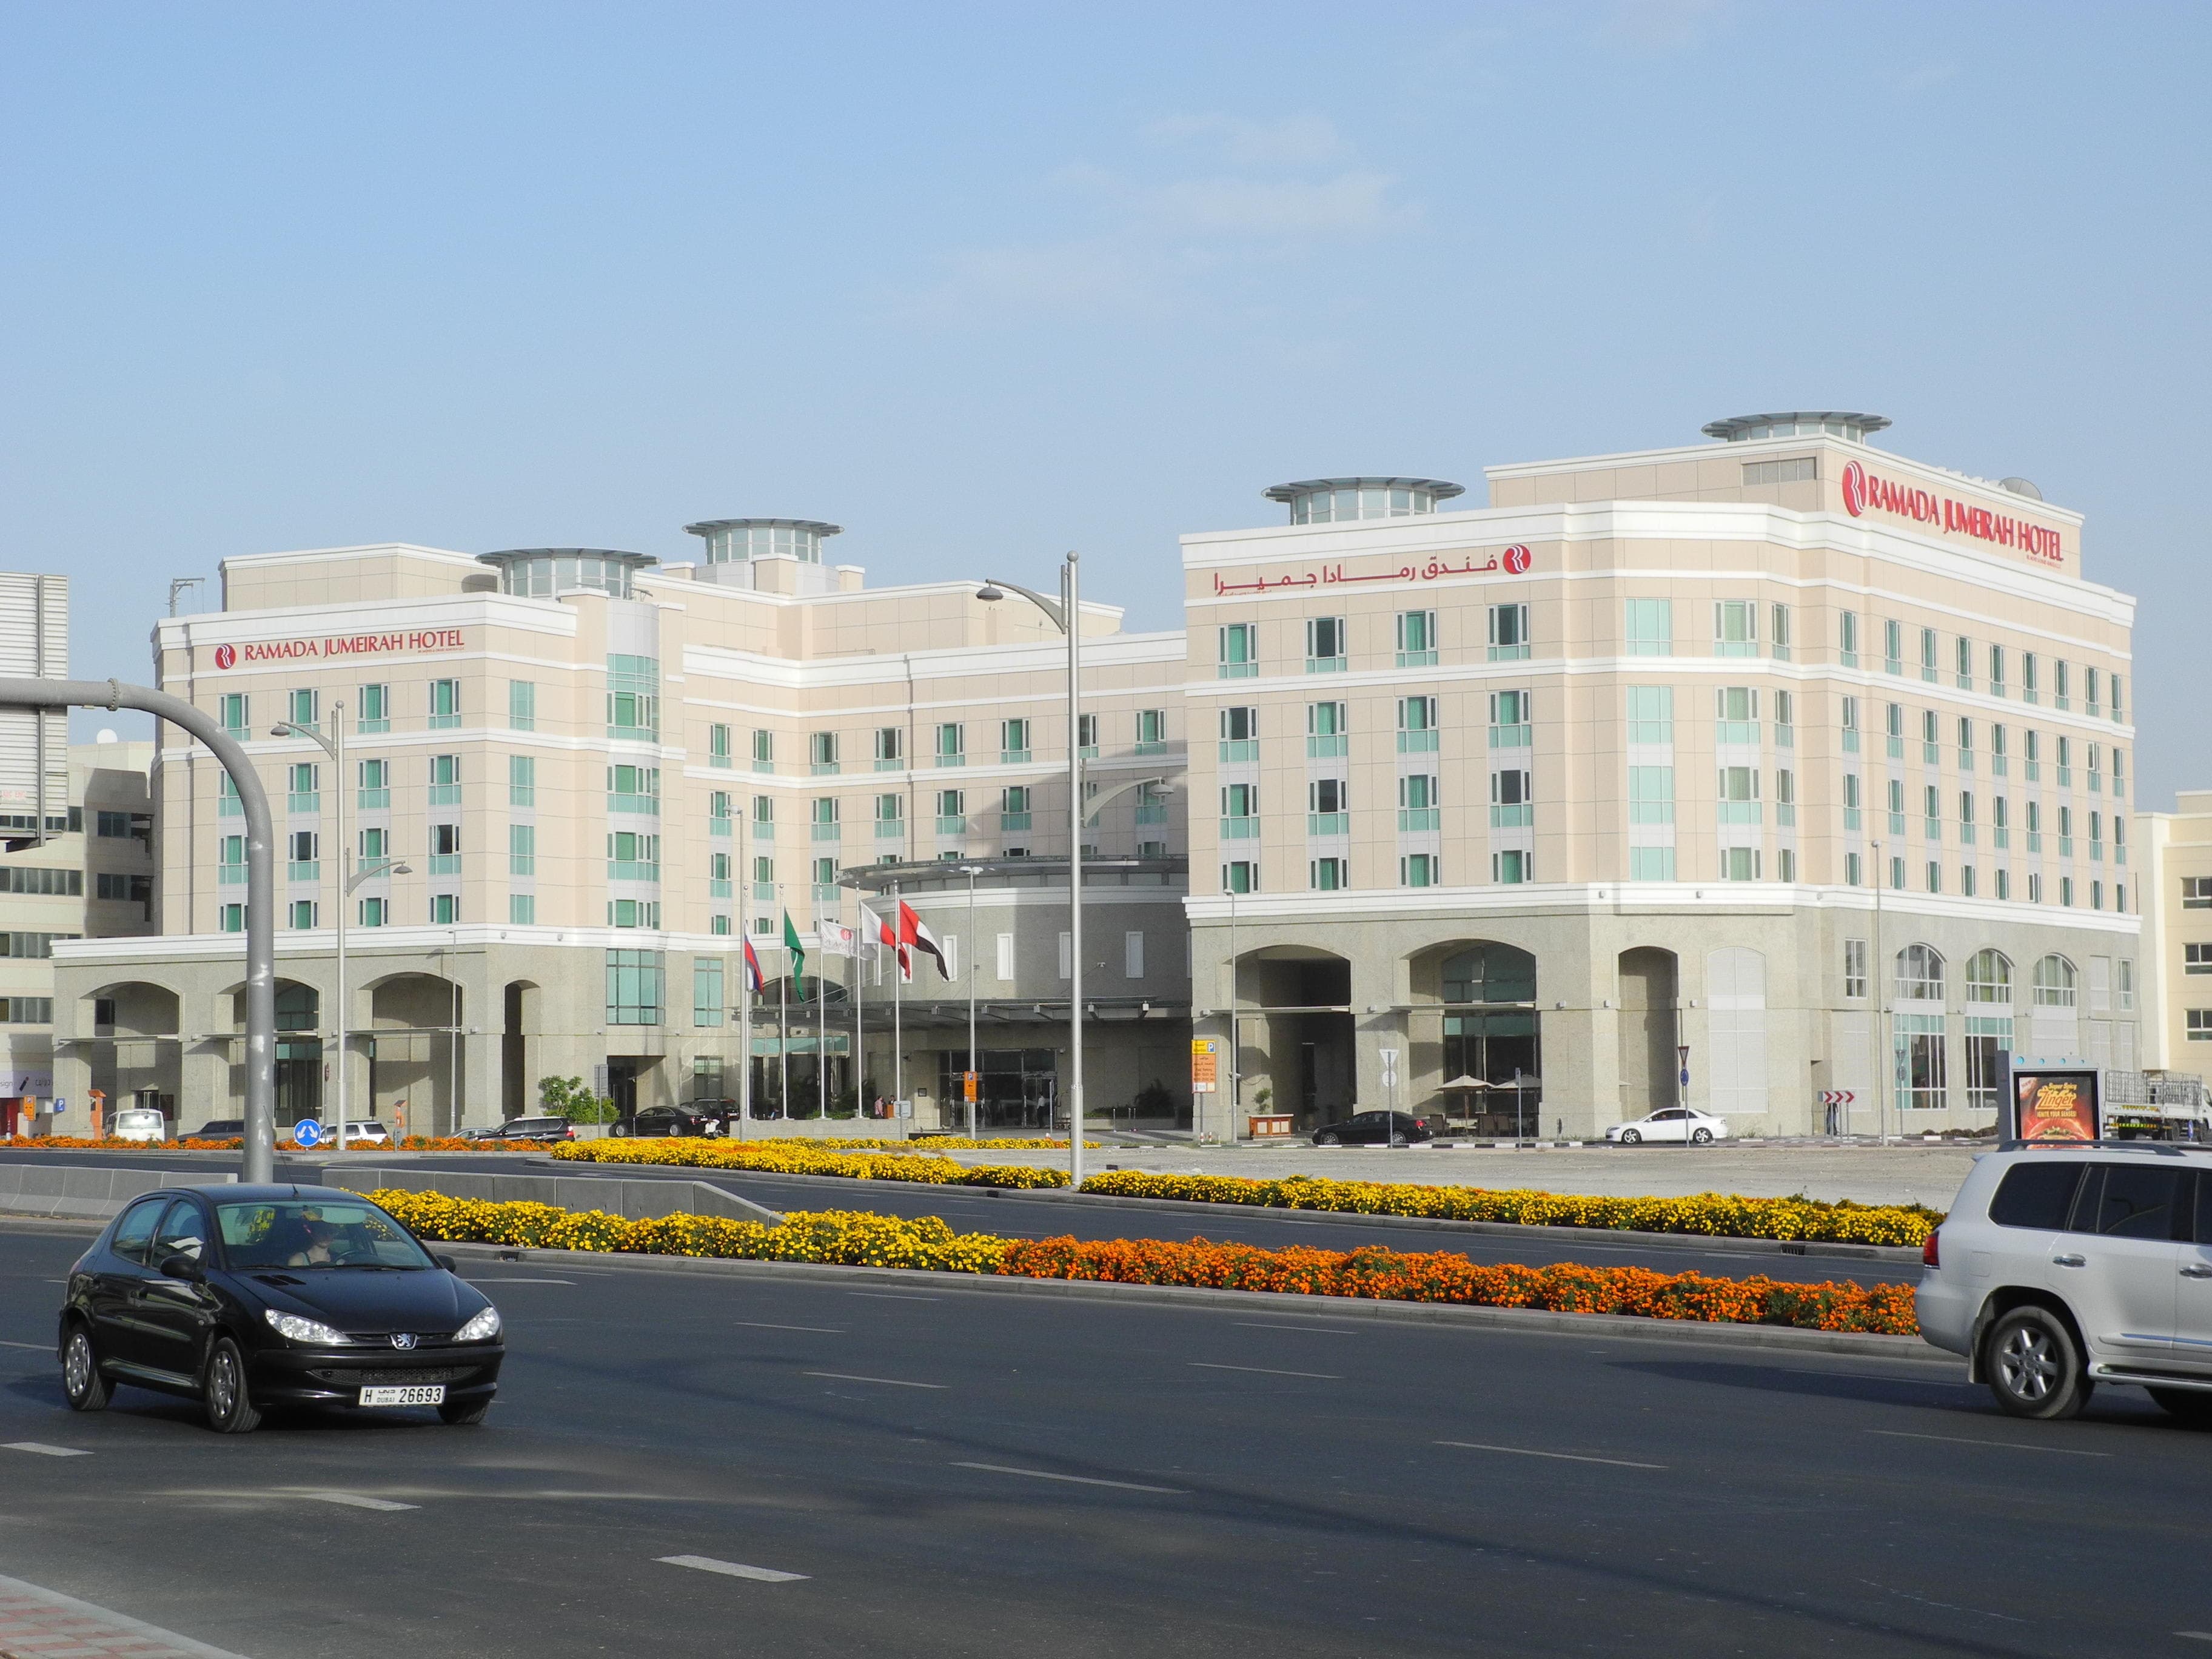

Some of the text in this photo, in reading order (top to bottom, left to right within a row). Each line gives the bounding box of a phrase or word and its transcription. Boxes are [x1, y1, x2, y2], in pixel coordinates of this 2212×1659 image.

[1869, 475, 1940, 526] RAMADA
[1943, 498, 2014, 548] JUMEIRAH
[2018, 520, 2063, 561] HOTEL
[1214, 554, 1498, 597] فندق رمادا جميرا
[245, 640, 318, 660] RAMADA
[323, 634, 403, 657] JUMEIRAH
[409, 629, 464, 649] HOTEL
[2037, 1091, 2074, 1108] Zinger
[364, 1389, 372, 1403] H
[399, 1388, 441, 1403] 26693
